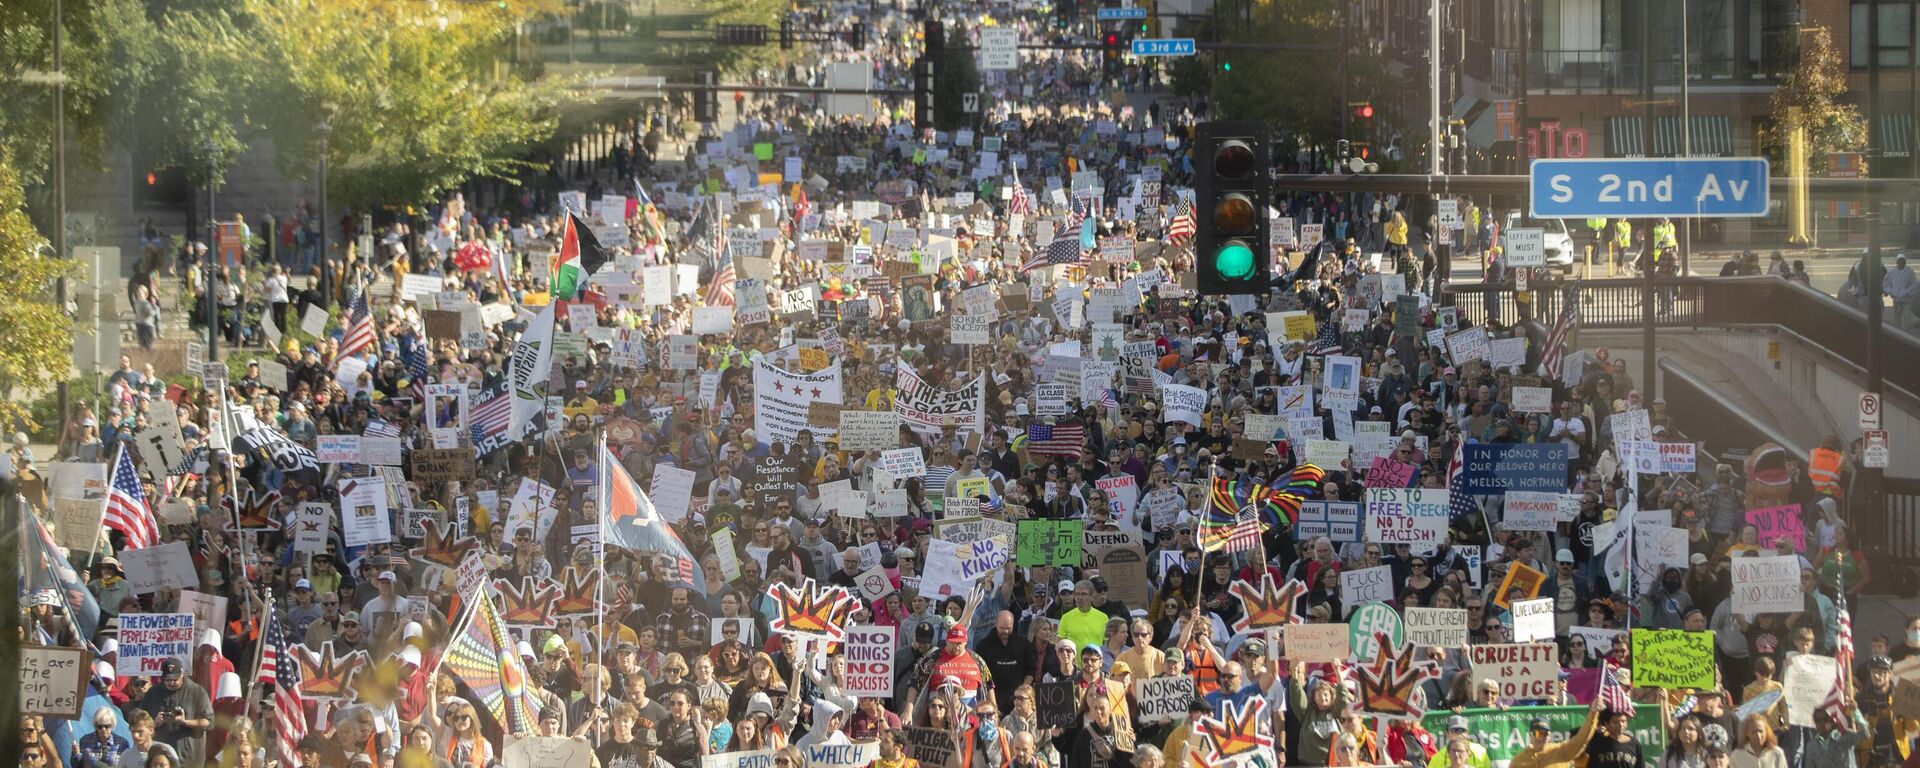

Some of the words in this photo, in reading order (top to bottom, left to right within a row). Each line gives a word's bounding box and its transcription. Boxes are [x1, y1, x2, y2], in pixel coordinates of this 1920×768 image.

[1151, 43, 1169, 52] 3rd
[1175, 43, 1188, 52] Av
[1141, 182, 1161, 196] GOP
[1550, 174, 1573, 203] S
[1598, 174, 1673, 203] 2nd
[1699, 174, 1749, 202] Av
[1141, 196, 1161, 208] OUT
[1516, 243, 1535, 251] MUST
[736, 278, 754, 289] EAT
[788, 290, 805, 303] NO
[740, 310, 767, 323] RICH
[951, 316, 964, 324] NO
[966, 316, 986, 324] KING
[951, 323, 974, 331] SINCE
[801, 359, 828, 369] KINGS
[1119, 355, 1142, 367] NO
[760, 362, 774, 374] WE
[805, 374, 835, 382] BACK!
[1126, 366, 1150, 378] KINGS
[914, 382, 940, 405] THE
[914, 400, 978, 415] GAZA!
[907, 409, 976, 424] PALESINE!
[1473, 450, 1491, 460] IN
[1500, 449, 1540, 460] HONOR
[1547, 450, 1565, 460] OF
[765, 457, 785, 466] Our
[1380, 458, 1404, 474] NO
[1470, 462, 1492, 472] OUR
[1495, 462, 1535, 472] BELOVED
[1539, 462, 1566, 472] HERO
[756, 465, 795, 475] Resistance
[767, 474, 782, 482] Will
[1369, 467, 1408, 487] DICK
[1469, 477, 1514, 488] MELISSA
[1519, 477, 1564, 488] HORTMAN
[754, 482, 781, 492] Outlast
[783, 482, 796, 490] the
[1096, 480, 1113, 490] YOU
[946, 498, 961, 507] Bitch
[961, 498, 979, 507] PLEASE
[1370, 488, 1397, 503] YES
[1404, 489, 1422, 504] TO
[303, 506, 324, 517] NO
[946, 508, 961, 516] You're
[1301, 506, 1321, 515] MAKE
[1330, 507, 1356, 516] ORWELL
[1369, 502, 1403, 517] FREE
[1405, 502, 1449, 517] SPEECH
[1506, 500, 1558, 512] IMMIGRANTS
[1376, 516, 1393, 529] NO
[1397, 516, 1414, 529] TO
[1754, 511, 1773, 532] NO
[1301, 526, 1328, 534] FICTION
[1332, 527, 1354, 535] AGAIN
[1085, 532, 1130, 545] DEFEND
[972, 539, 994, 558] NO
[961, 547, 1008, 580] KINGS
[1346, 570, 1384, 587] FUCK
[1732, 563, 1748, 584] NO
[1749, 562, 1799, 581] DICTATORS
[1352, 582, 1380, 603] ICE
[1741, 586, 1761, 602] NO
[1763, 584, 1799, 601] KINGS
[120, 616, 139, 629] THE
[139, 615, 169, 629] POWER
[169, 615, 180, 627] OF
[180, 615, 194, 627] THE
[1357, 604, 1398, 634] ERA
[1406, 610, 1437, 627] ONLY
[1438, 610, 1467, 626] GREAT
[119, 628, 149, 643] PEOPLE
[149, 630, 157, 641] IS
[157, 628, 193, 644] STRONGER
[848, 632, 890, 644] NO
[1404, 628, 1443, 645] WITHOUT
[1443, 628, 1465, 646] HATE
[1585, 633, 1603, 641] ONLY
[119, 643, 138, 658] THAN
[150, 642, 176, 656] PEOPLE
[176, 642, 189, 655] IN
[847, 646, 890, 661] KINGS
[1473, 645, 1553, 665] CRUELTY
[47, 658, 75, 669] are
[847, 662, 890, 674] NO
[19, 667, 51, 679] the
[1500, 666, 1513, 677] IS
[1520, 666, 1531, 676] A
[846, 676, 889, 691] FASCISTS
[1142, 681, 1162, 699] NO
[1162, 678, 1193, 696] KINGS
[1498, 680, 1555, 697] OICE
[1039, 685, 1065, 706] NO
[1138, 700, 1155, 716] NO
[1043, 709, 1075, 726] Kings
[810, 745, 863, 765] WHICH
[913, 746, 950, 767] BUILT
